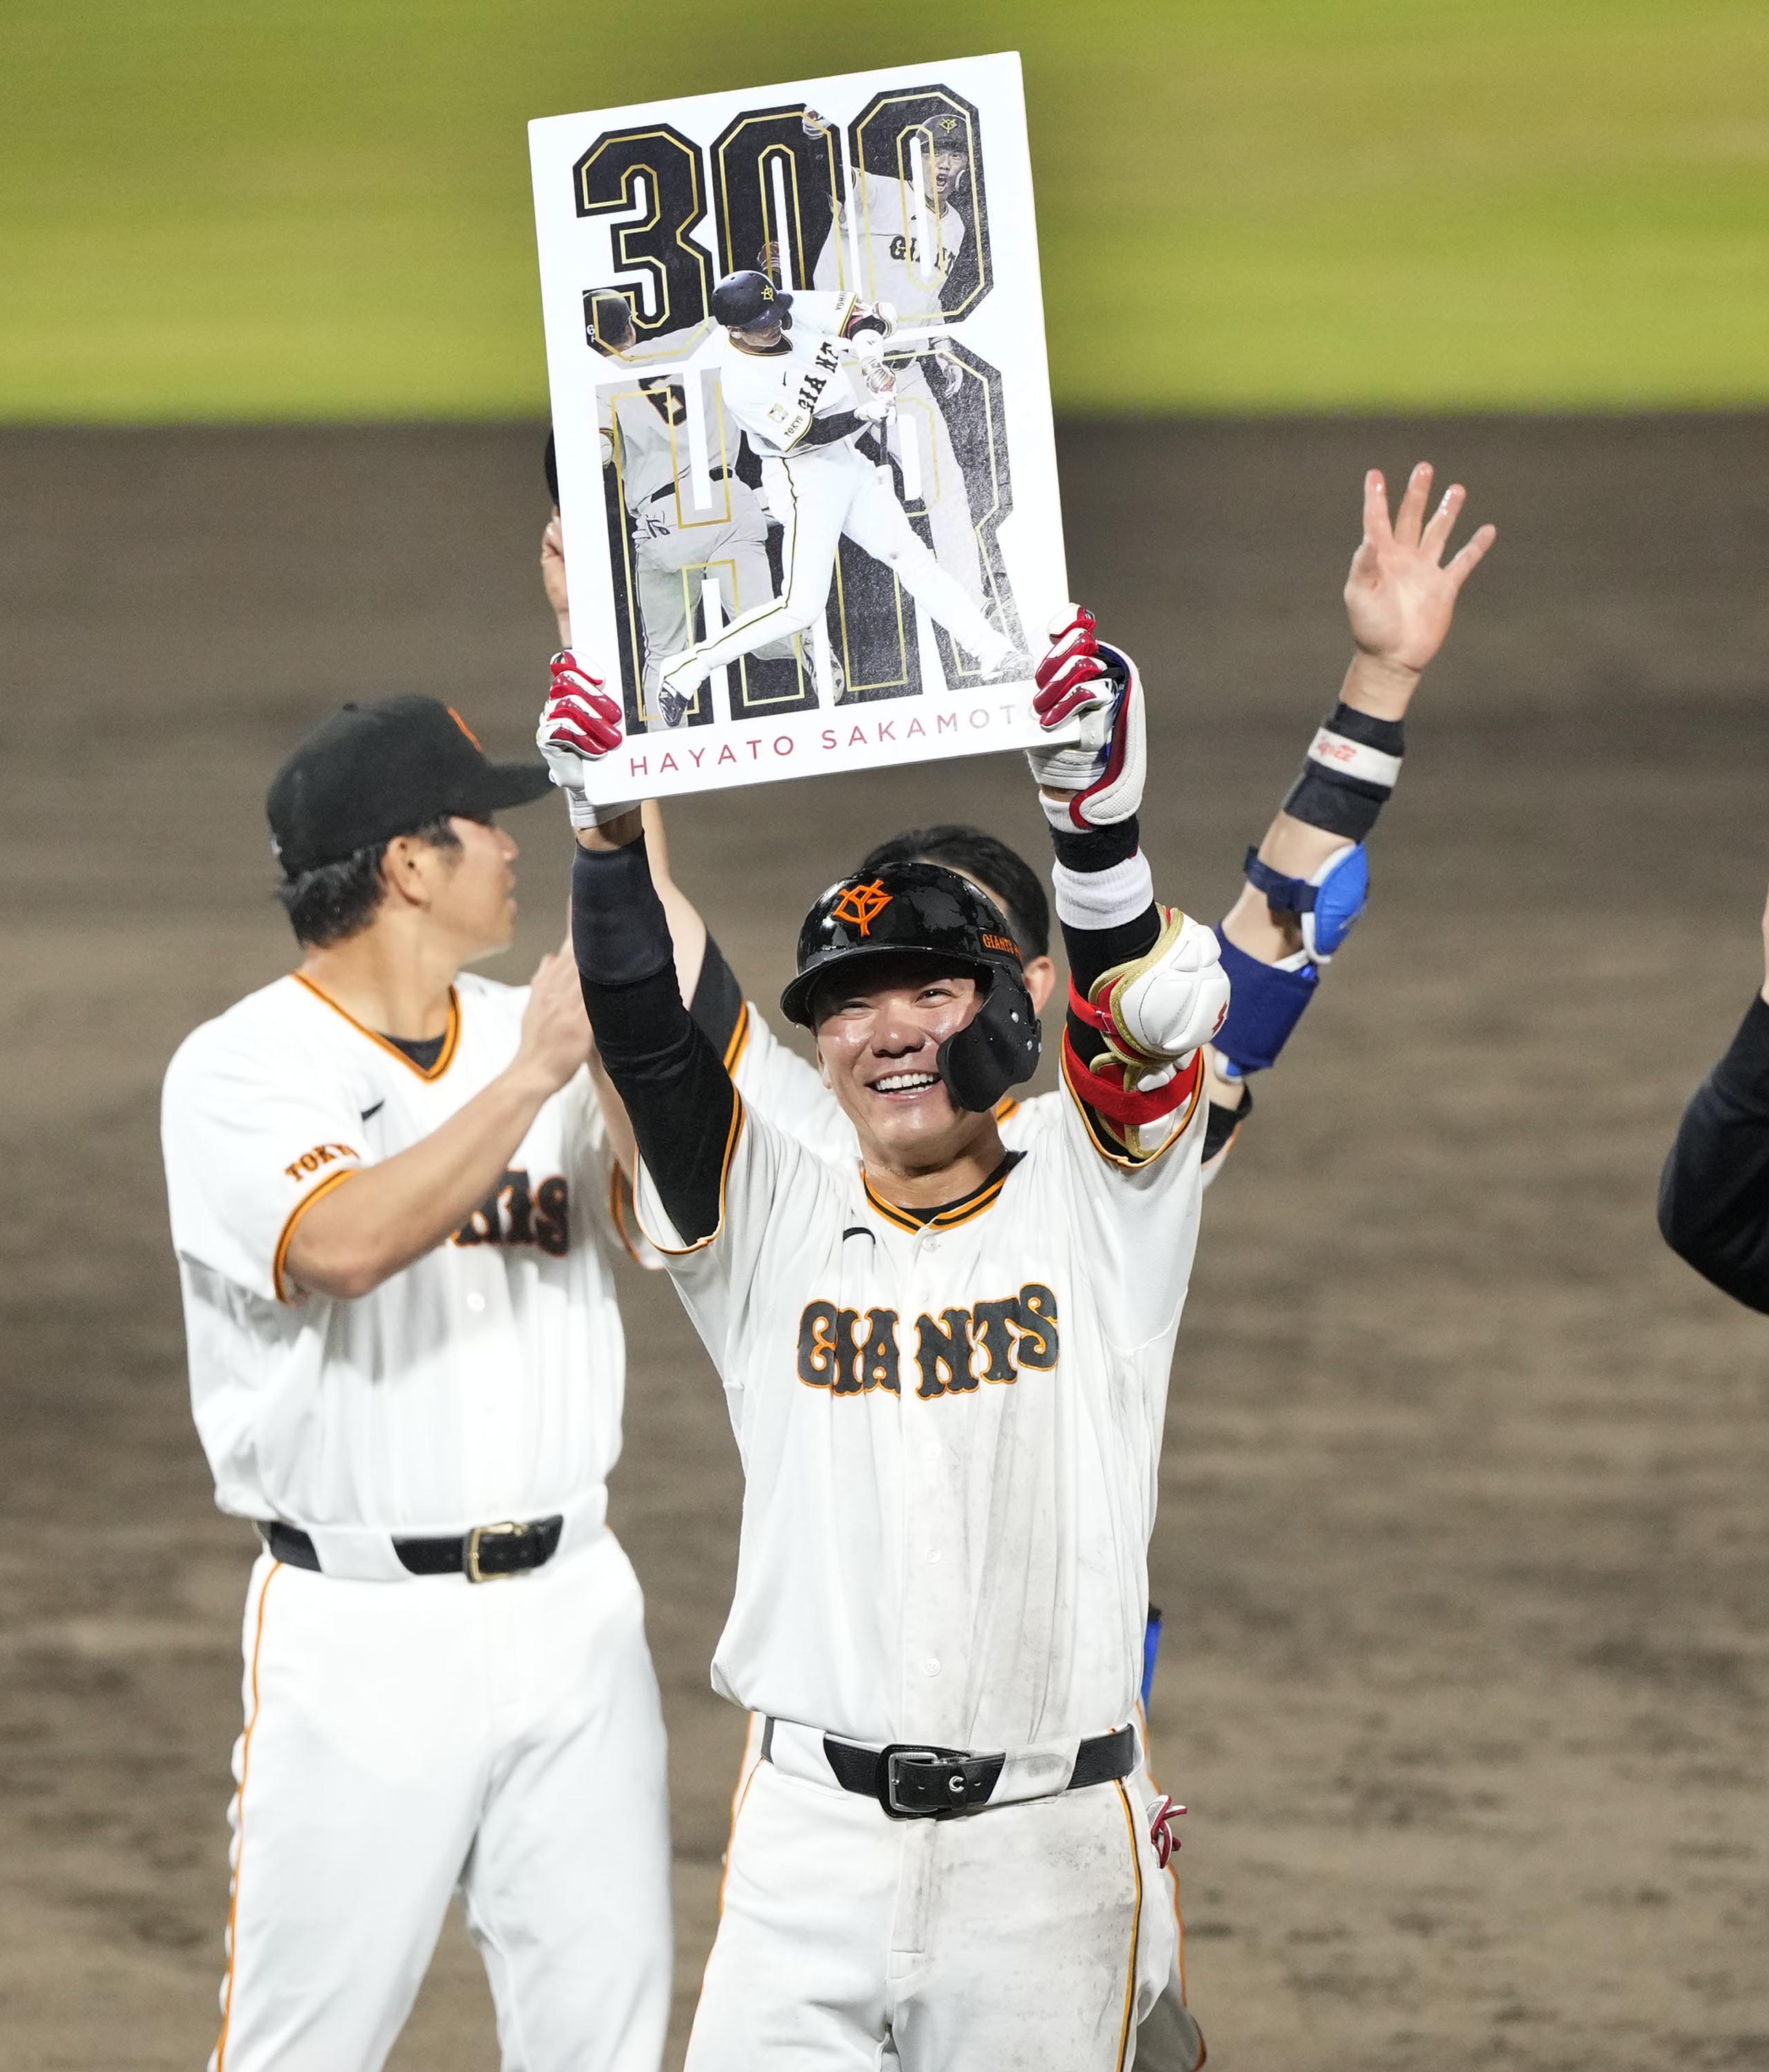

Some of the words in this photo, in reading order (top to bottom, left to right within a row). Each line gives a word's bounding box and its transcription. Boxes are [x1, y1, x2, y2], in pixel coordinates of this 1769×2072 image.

[573, 84, 995, 369] 300
[798, 341, 839, 414] GIANT
[630, 736, 794, 777] HAYATO
[797, 1282, 1059, 1400] GIANTS
